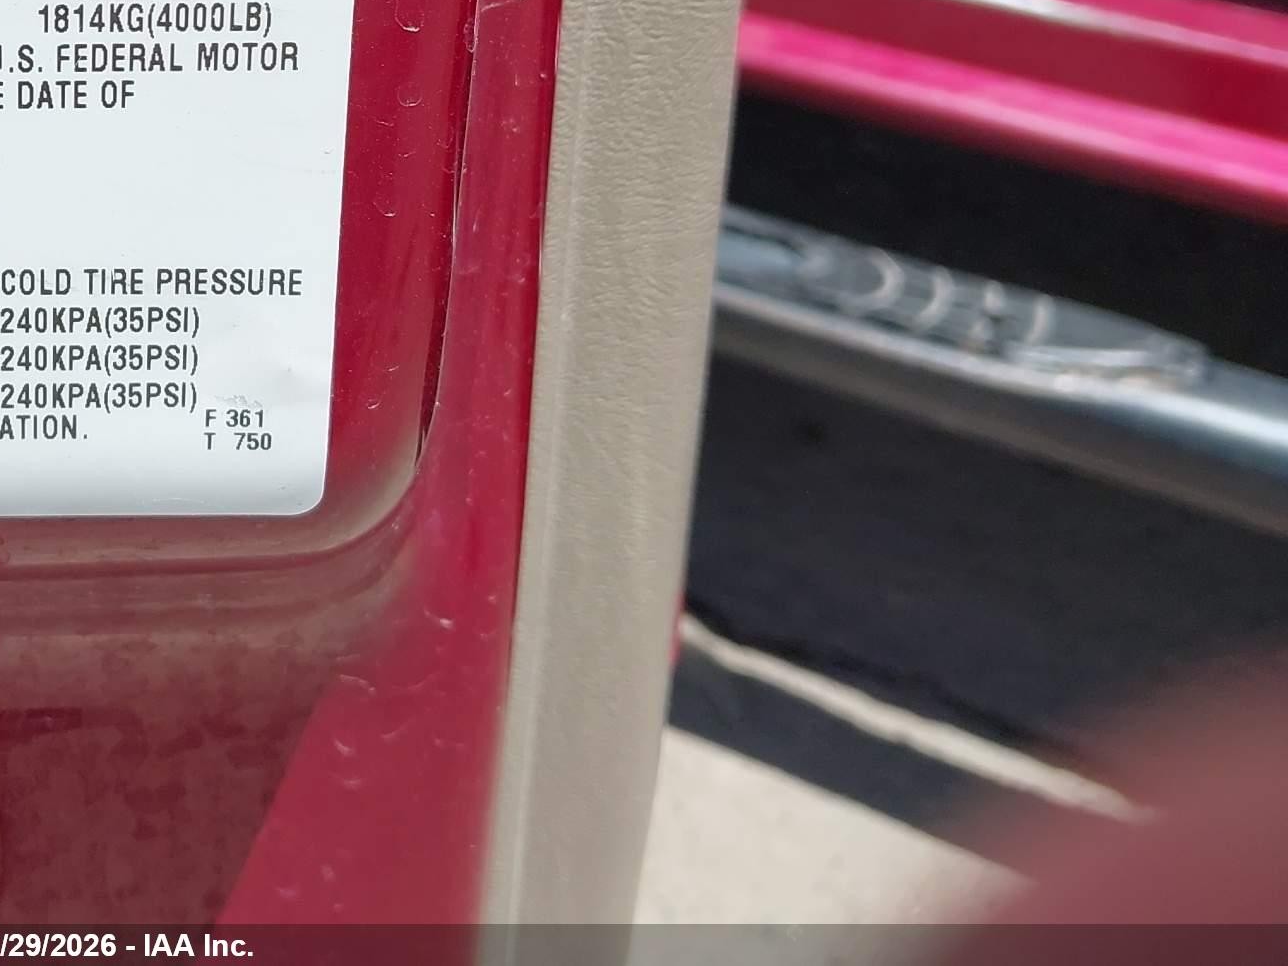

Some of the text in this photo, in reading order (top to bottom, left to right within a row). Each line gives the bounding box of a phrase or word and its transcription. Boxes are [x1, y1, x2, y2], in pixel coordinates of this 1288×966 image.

[39, 2, 271, 38] 1814KG(4000LB)
[57, 43, 183, 72] FEDERAL
[198, 42, 298, 71] MOTOR
[18, 81, 87, 109] DATE
[101, 80, 134, 108] OF
[2, 269, 302, 295] COLD TIRE PRESSURE
[1, 307, 199, 338] 240KPA(35PSI)
[1, 345, 198, 376] 240KPA(35PSI)
[1, 382, 196, 413] 240KPA(35PSI)
[206, 409, 263, 427] F 361
[204, 433, 271, 450] T 750
